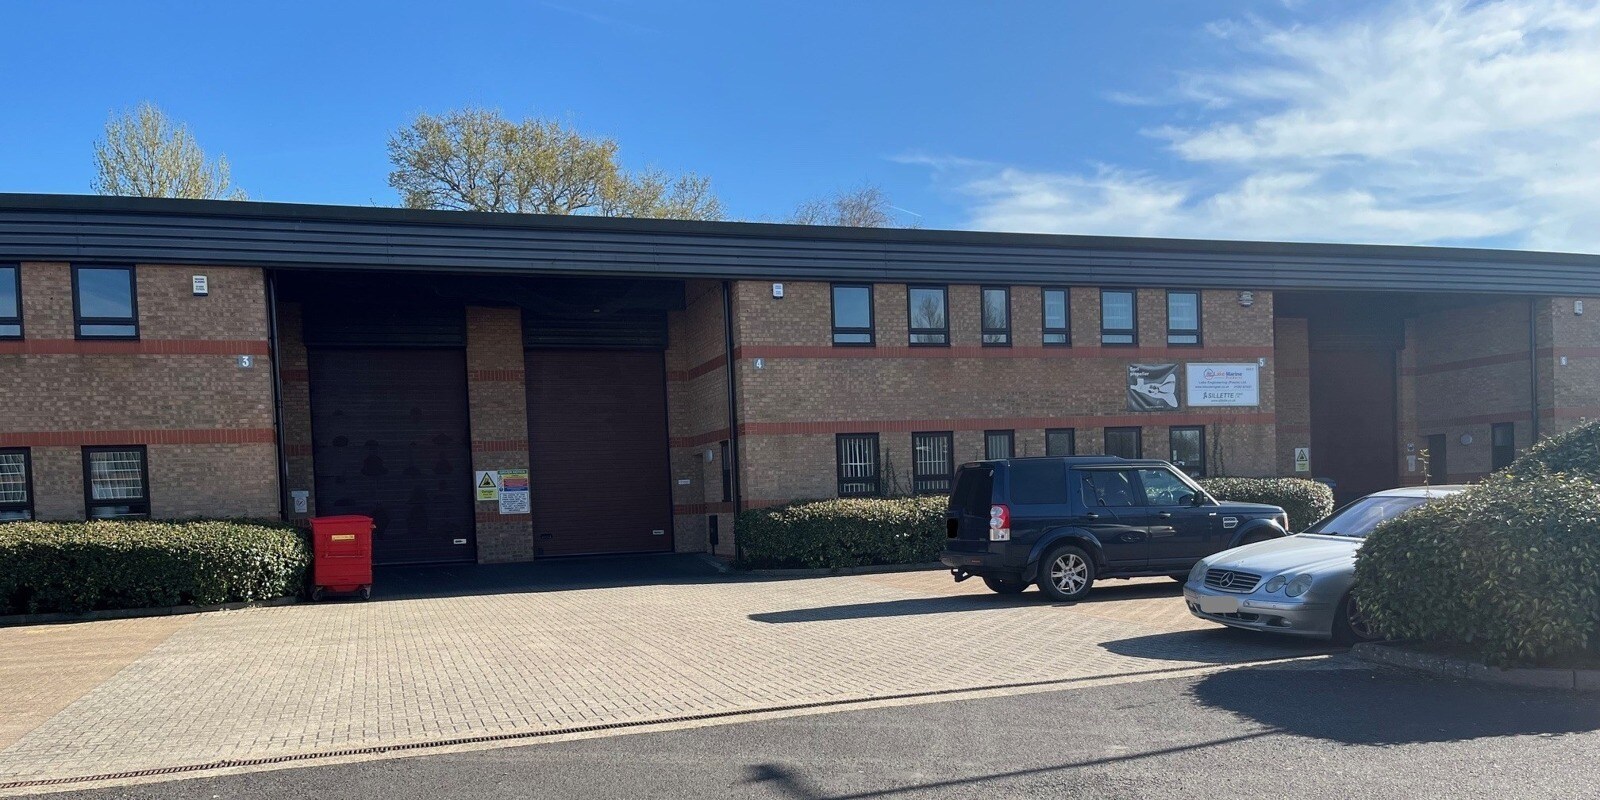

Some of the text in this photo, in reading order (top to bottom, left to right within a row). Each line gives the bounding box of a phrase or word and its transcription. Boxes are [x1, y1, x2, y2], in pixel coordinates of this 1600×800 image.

[242, 356, 249, 367] 3
[756, 358, 762, 368] 4
[1259, 358, 1264, 367] 5
[1561, 357, 1566, 365] 6
